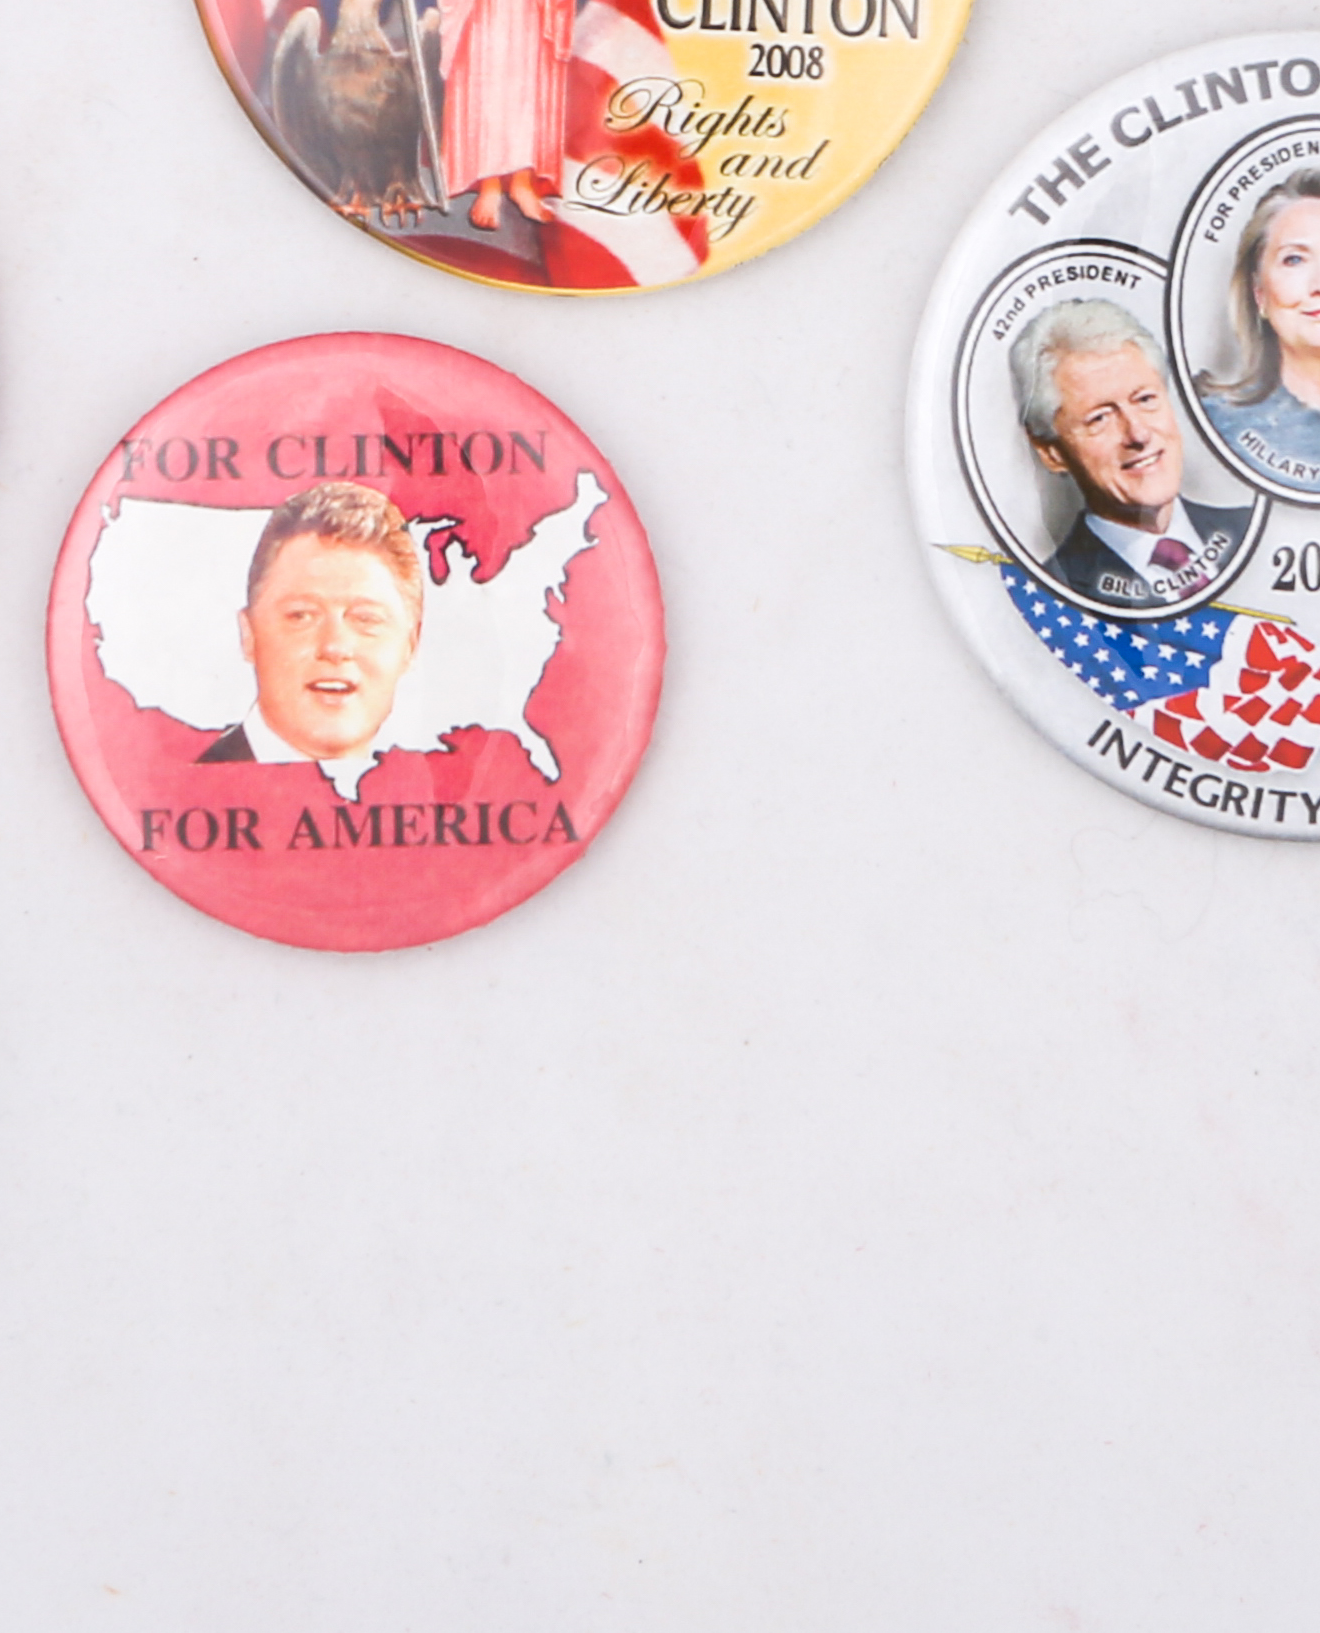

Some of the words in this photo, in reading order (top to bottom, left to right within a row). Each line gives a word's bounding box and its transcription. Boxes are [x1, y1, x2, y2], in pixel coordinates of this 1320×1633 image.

[748, 44, 825, 79] 2008
[605, 77, 788, 158] Rights
[720, 139, 831, 180] and
[1009, 142, 1113, 228] THE
[565, 155, 758, 242] Liberty
[1204, 201, 1234, 243] FOR
[992, 297, 1027, 341] 42nd
[1026, 264, 1142, 299] PRESIDENT
[121, 437, 243, 483] FOR
[266, 430, 549, 481] CLINTON
[1240, 430, 1320, 481] HILLARY
[1100, 575, 1145, 598] BILL
[1153, 533, 1229, 595] CLINTON
[140, 806, 263, 852] FOR
[287, 800, 582, 851] AMERICA
